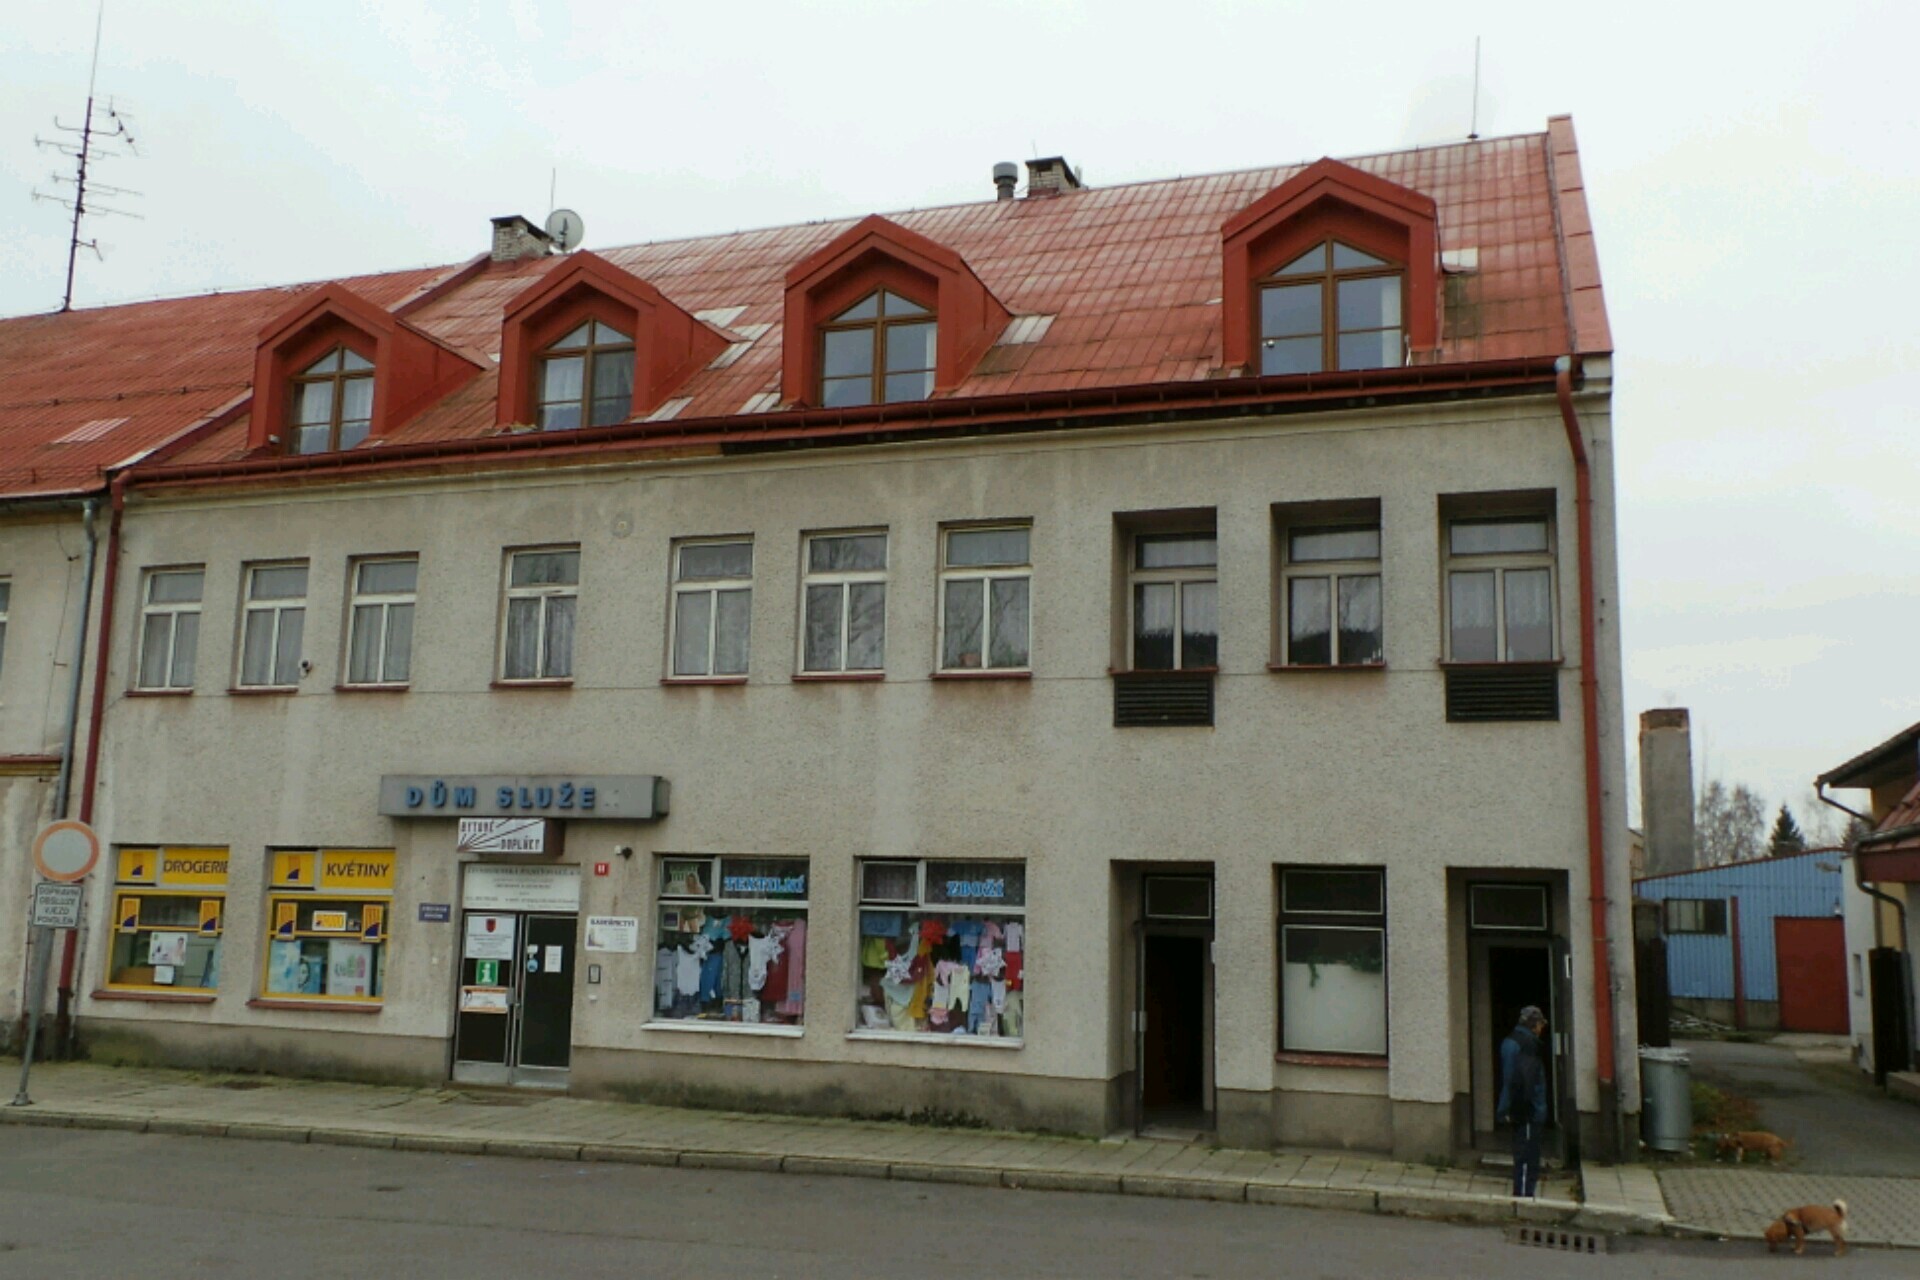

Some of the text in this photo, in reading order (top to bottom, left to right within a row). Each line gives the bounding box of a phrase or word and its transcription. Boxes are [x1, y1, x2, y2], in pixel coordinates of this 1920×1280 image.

[406, 780, 596, 810] DŮM SLUŽE
[947, 878, 1005, 898] ZBOŽÍ
